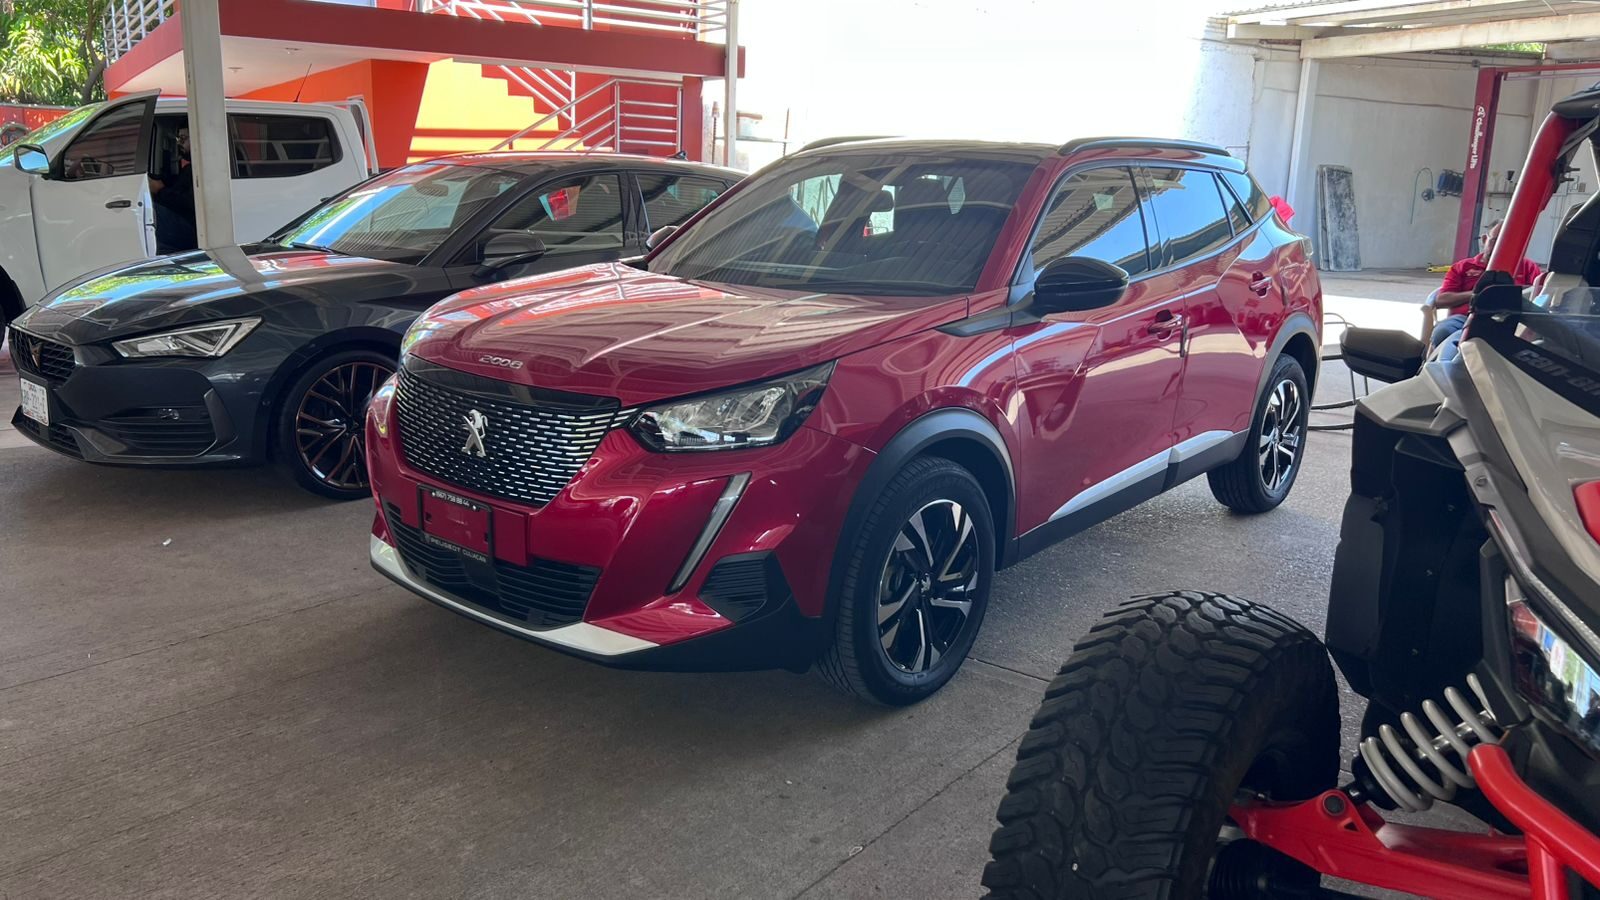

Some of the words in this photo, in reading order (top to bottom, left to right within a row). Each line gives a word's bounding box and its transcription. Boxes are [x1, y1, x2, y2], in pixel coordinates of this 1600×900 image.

[1471, 117, 1483, 154] Challenger
[1470, 155, 1478, 168] Lifts
[479, 354, 523, 369] 2008
[430, 537, 460, 552] PEUGEOT
